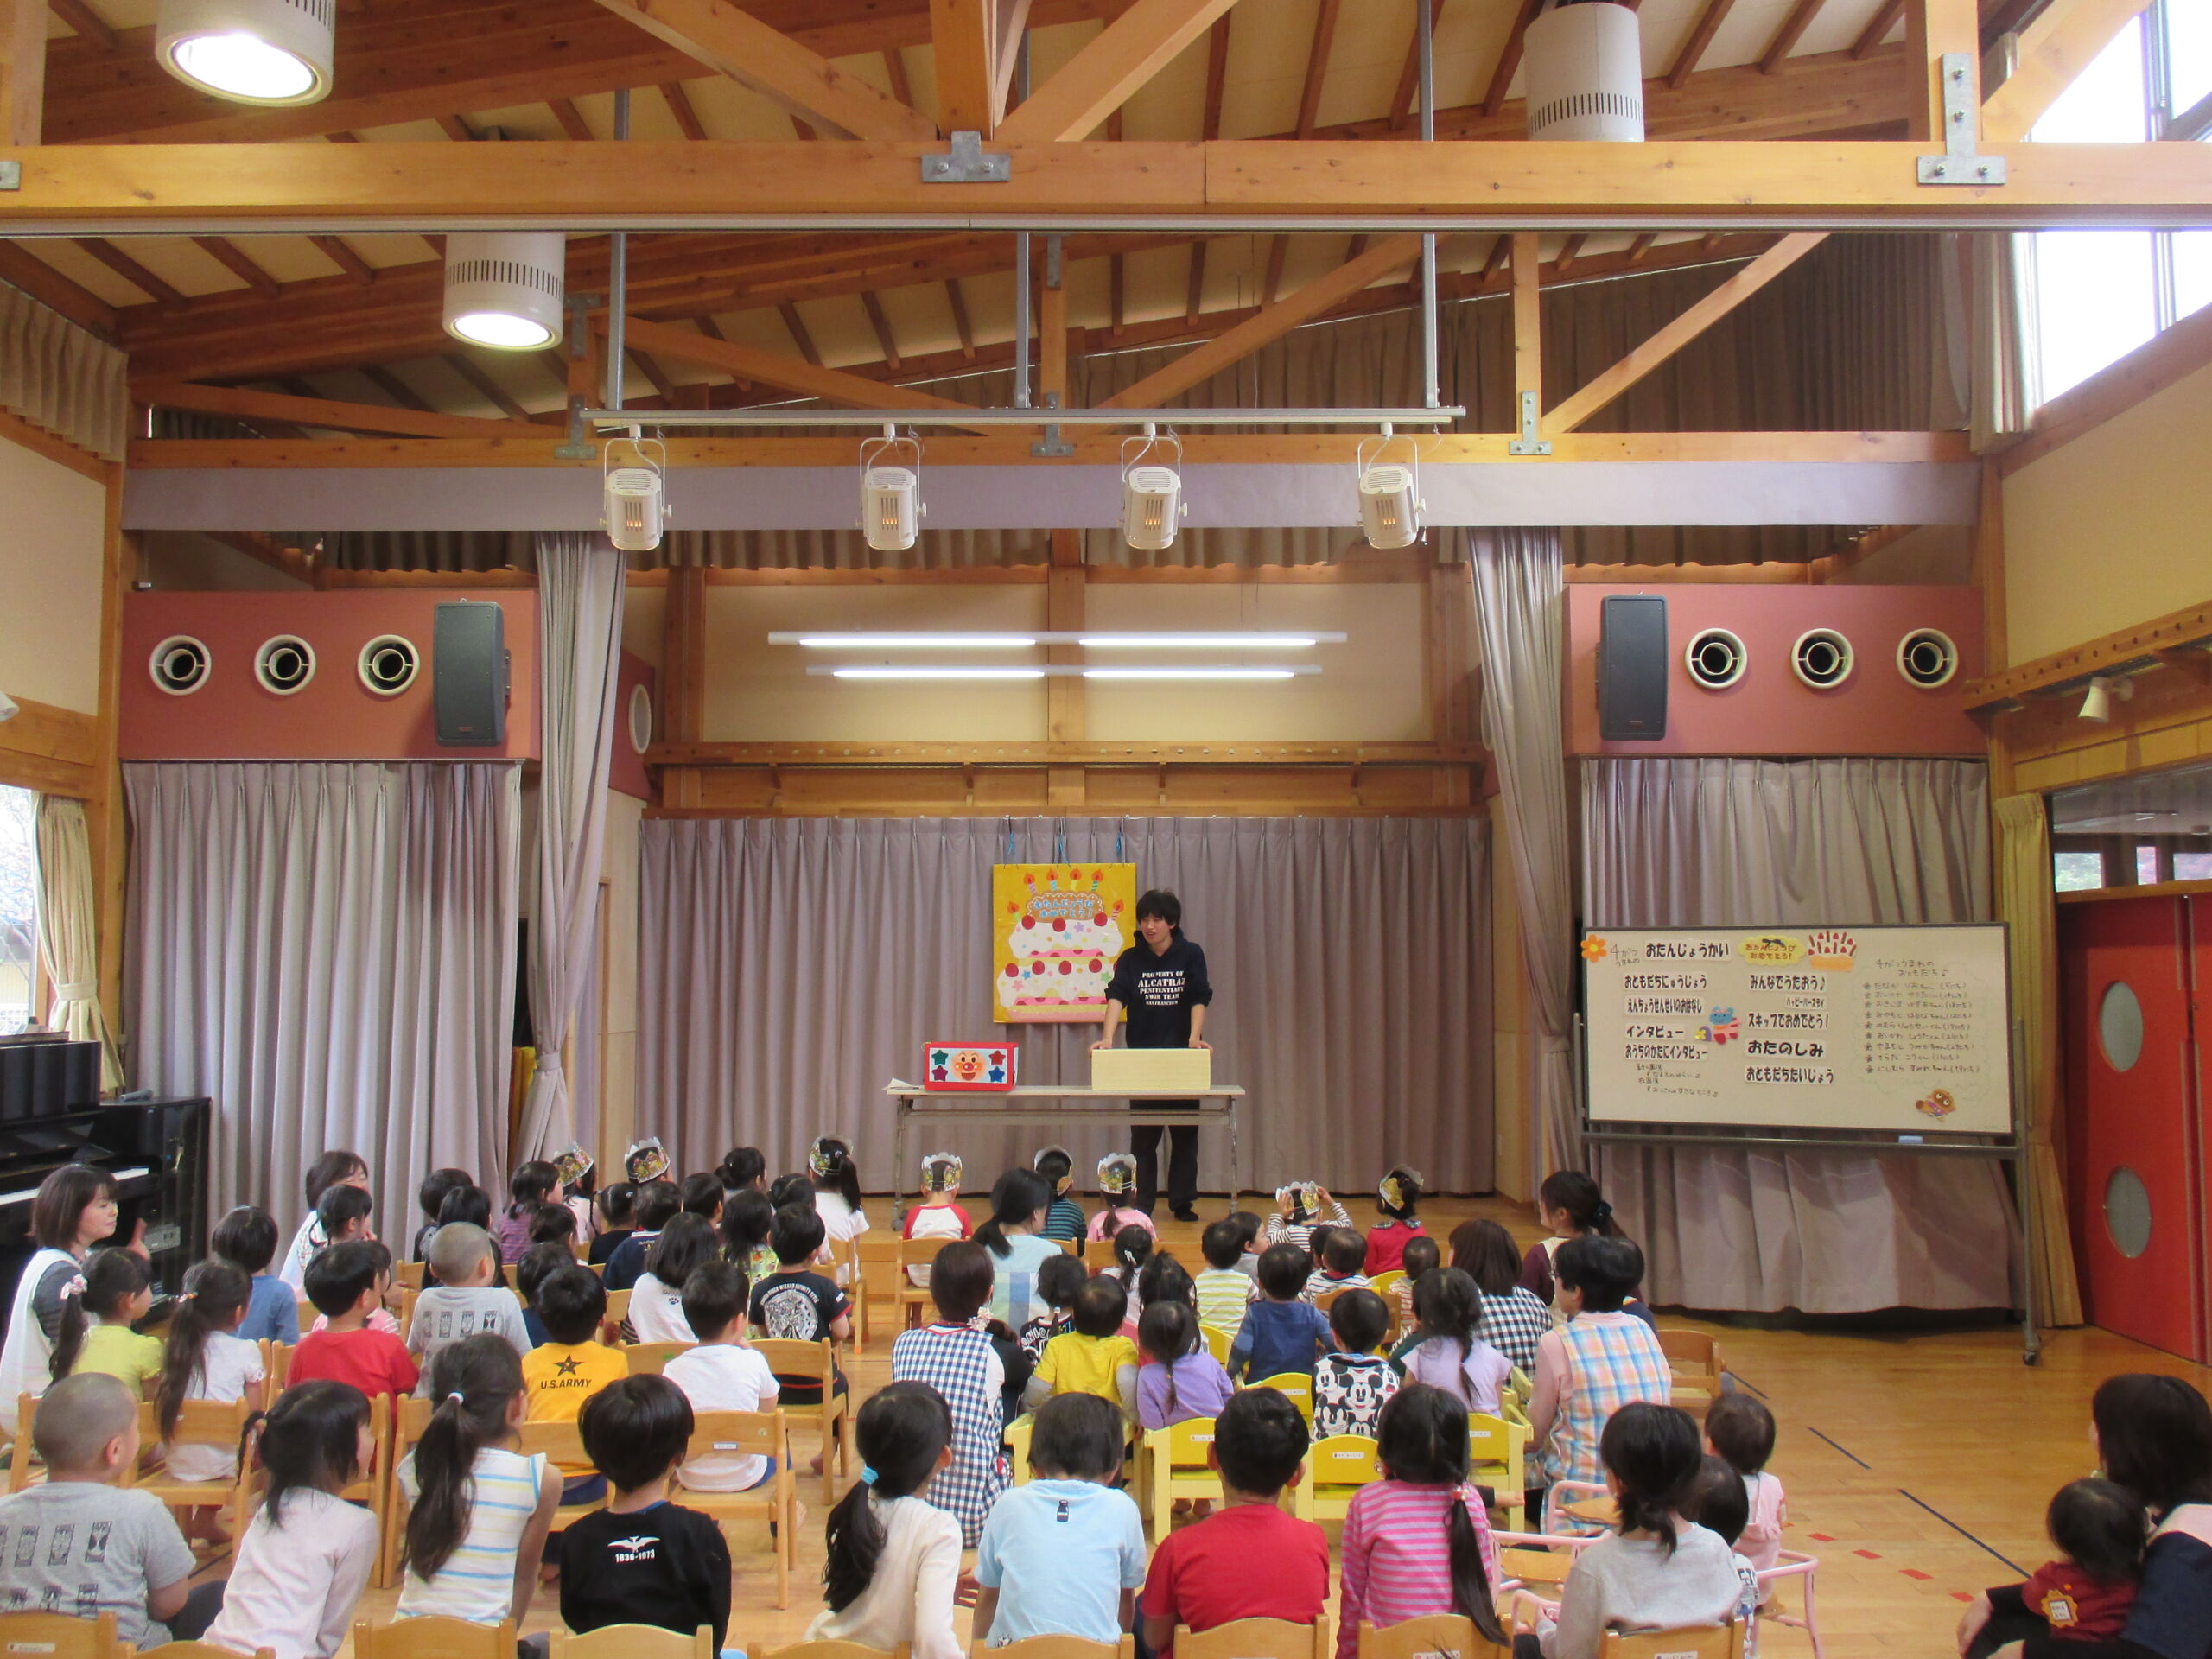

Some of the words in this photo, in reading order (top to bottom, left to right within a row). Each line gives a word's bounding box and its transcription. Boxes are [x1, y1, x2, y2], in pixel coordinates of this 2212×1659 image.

[1646, 943, 1729, 958] おたんじょうかい
[1137, 977, 1186, 988] ALCATRAZ
[1624, 974, 1707, 989] おともだちにゅうじょう
[1626, 1024, 1685, 1039] インタビュー
[1625, 1043, 1708, 1060] おうちのかたにインタビュー
[1747, 1039, 1825, 1058] おたのしみ
[1746, 1066, 1834, 1084] おともだちたいじょう
